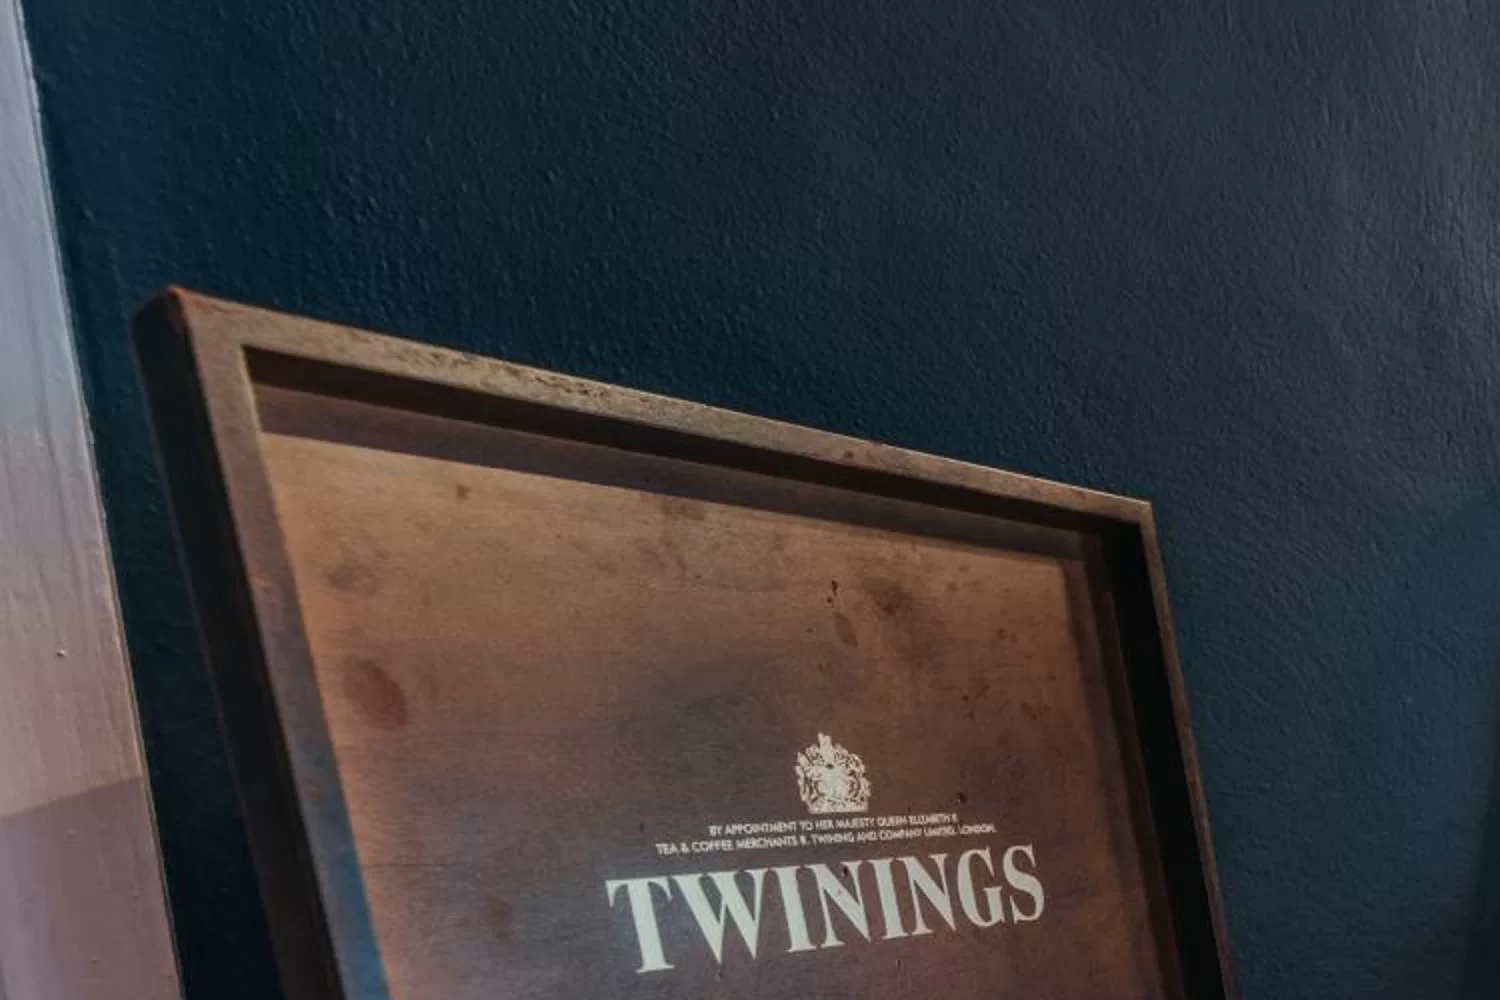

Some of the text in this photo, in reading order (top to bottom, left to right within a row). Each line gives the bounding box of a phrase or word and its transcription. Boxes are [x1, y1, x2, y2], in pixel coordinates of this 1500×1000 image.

[836, 816, 875, 829] MAJESTY
[656, 842, 679, 856] TEA
[691, 839, 734, 853] COFFEE
[735, 835, 798, 849] MERCHANTS
[605, 844, 1046, 974] TWININGS
